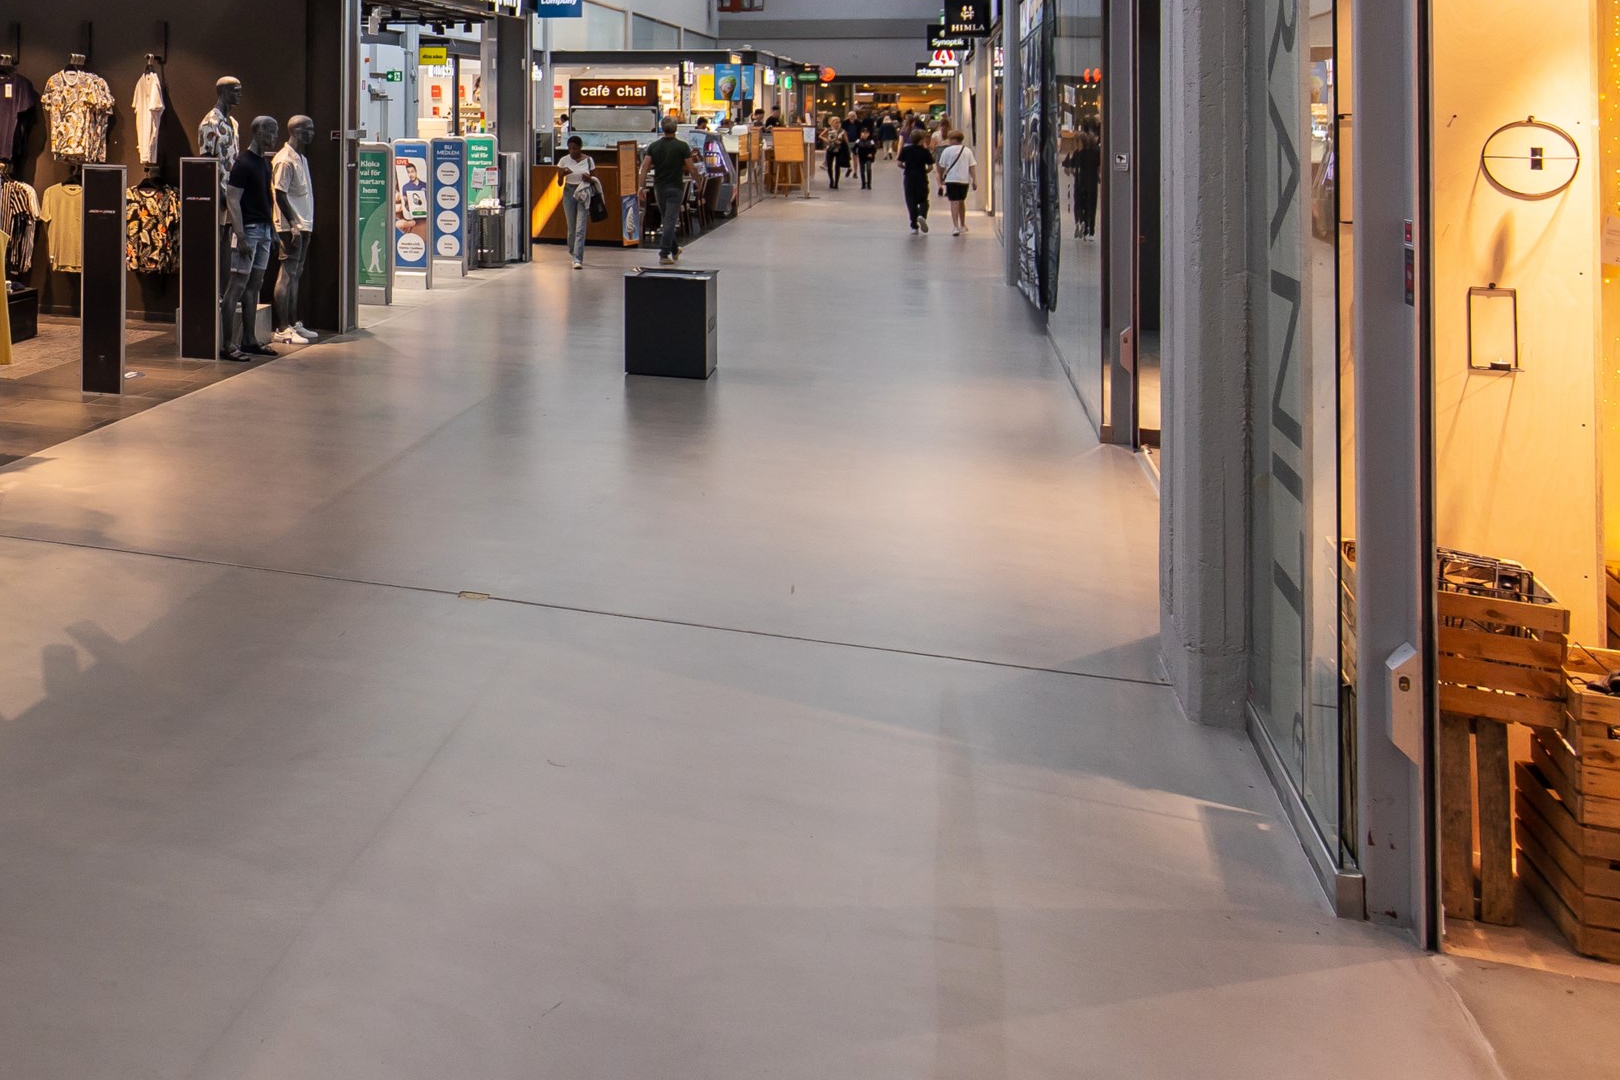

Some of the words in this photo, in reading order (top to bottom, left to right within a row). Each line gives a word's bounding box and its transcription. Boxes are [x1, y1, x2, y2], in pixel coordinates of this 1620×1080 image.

[951, 24, 985, 32] HIMLA
[932, 38, 964, 47] Synoptik
[916, 67, 955, 77] stadium
[580, 85, 610, 97] café
